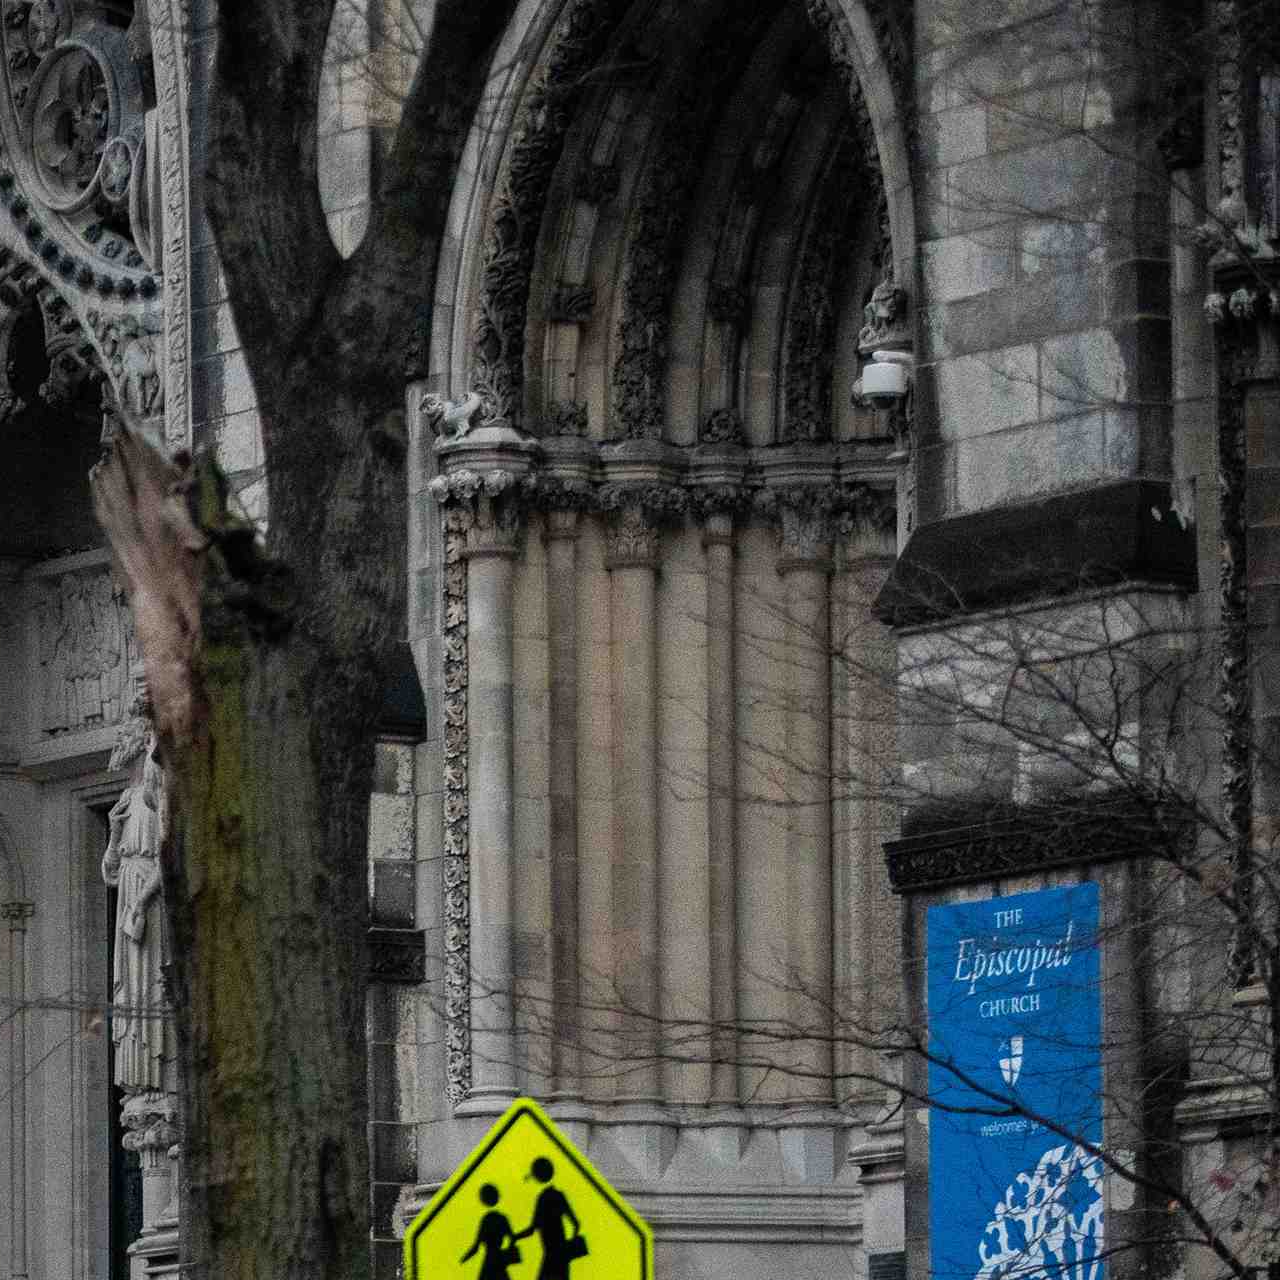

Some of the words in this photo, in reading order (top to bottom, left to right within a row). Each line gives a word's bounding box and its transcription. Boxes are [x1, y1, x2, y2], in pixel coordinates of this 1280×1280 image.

[993, 908, 1024, 929] THE
[953, 920, 1073, 995] Episcopal
[979, 994, 1040, 1019] CHURCH
